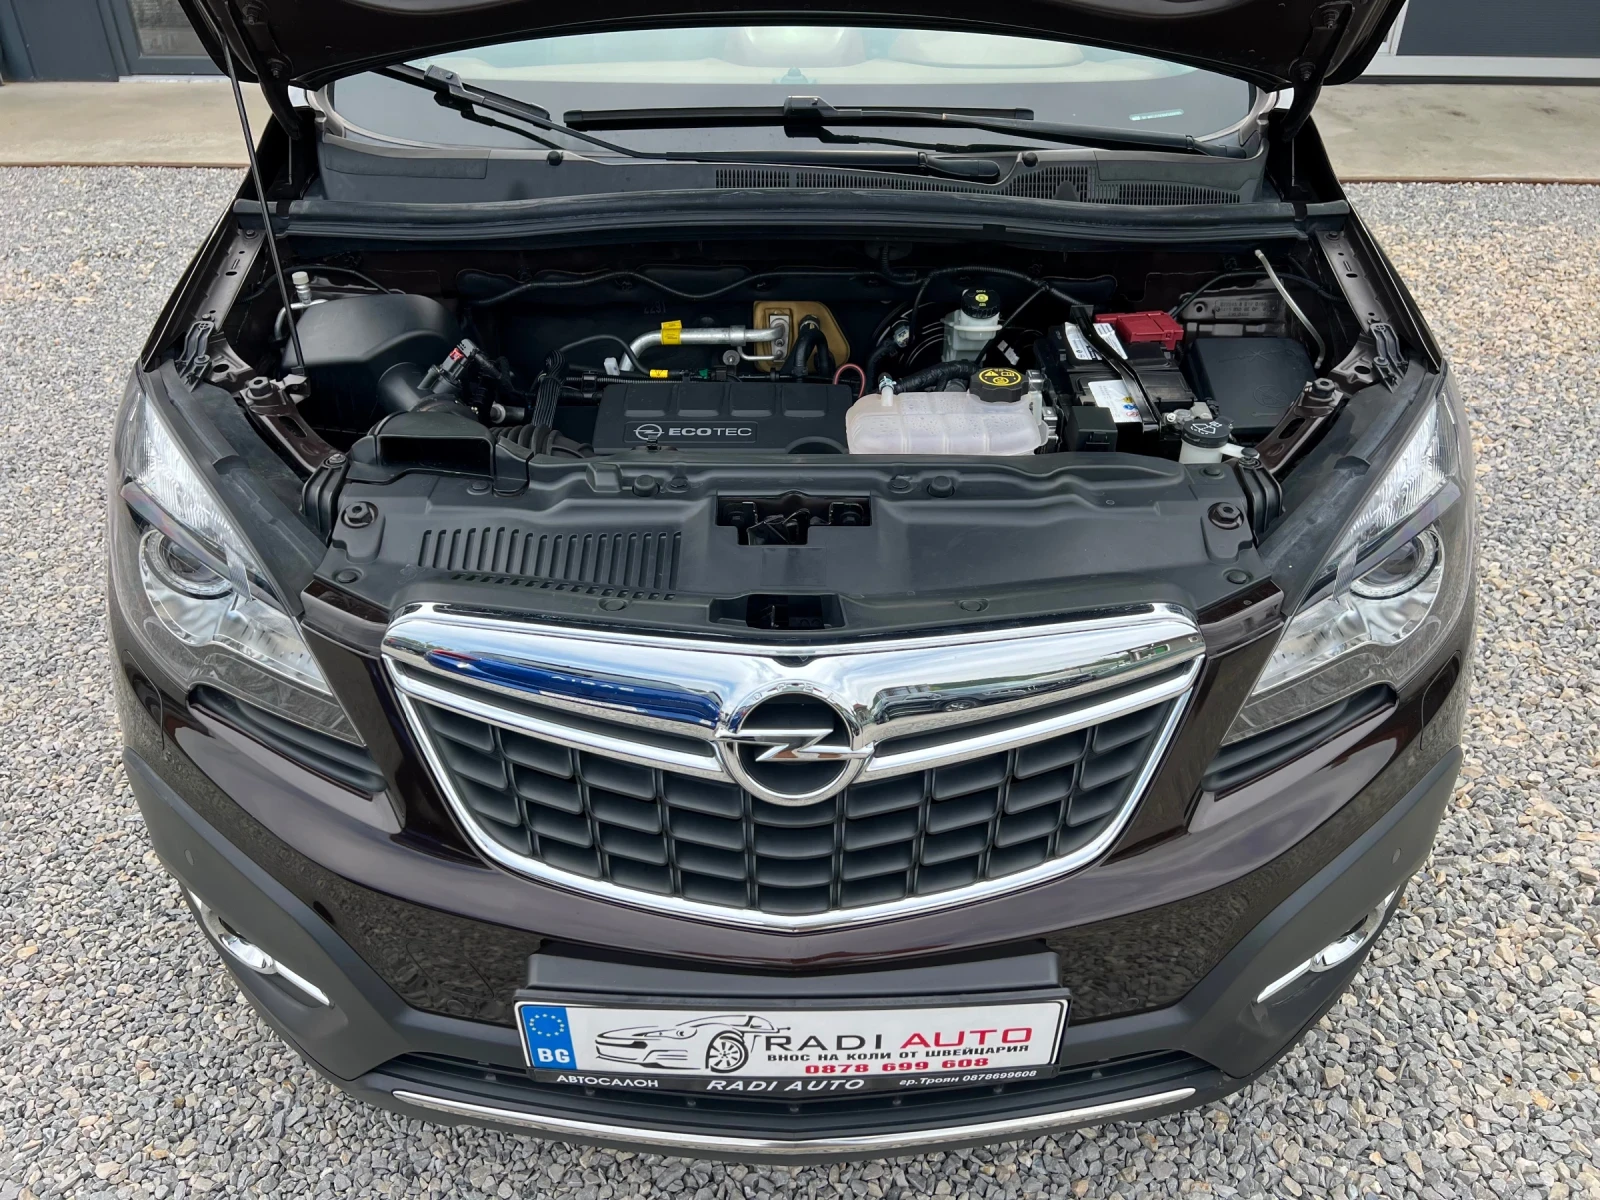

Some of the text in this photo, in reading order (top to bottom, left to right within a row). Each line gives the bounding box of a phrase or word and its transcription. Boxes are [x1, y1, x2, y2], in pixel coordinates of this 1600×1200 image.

[668, 427, 752, 437] ECOTEC
[765, 1027, 1032, 1051] RADI AUTO
[537, 1048, 571, 1064] BG
[767, 1045, 1029, 1062] ВНОС НА КОЛИ ОТ ШВЕЙЦАРИЯ
[805, 1057, 989, 1074] 0878 699 608
[556, 1074, 659, 1088] АВТОСАЛОН
[962, 1070, 1037, 1082] 0878699608
[706, 1079, 865, 1092] RADI AUTO
